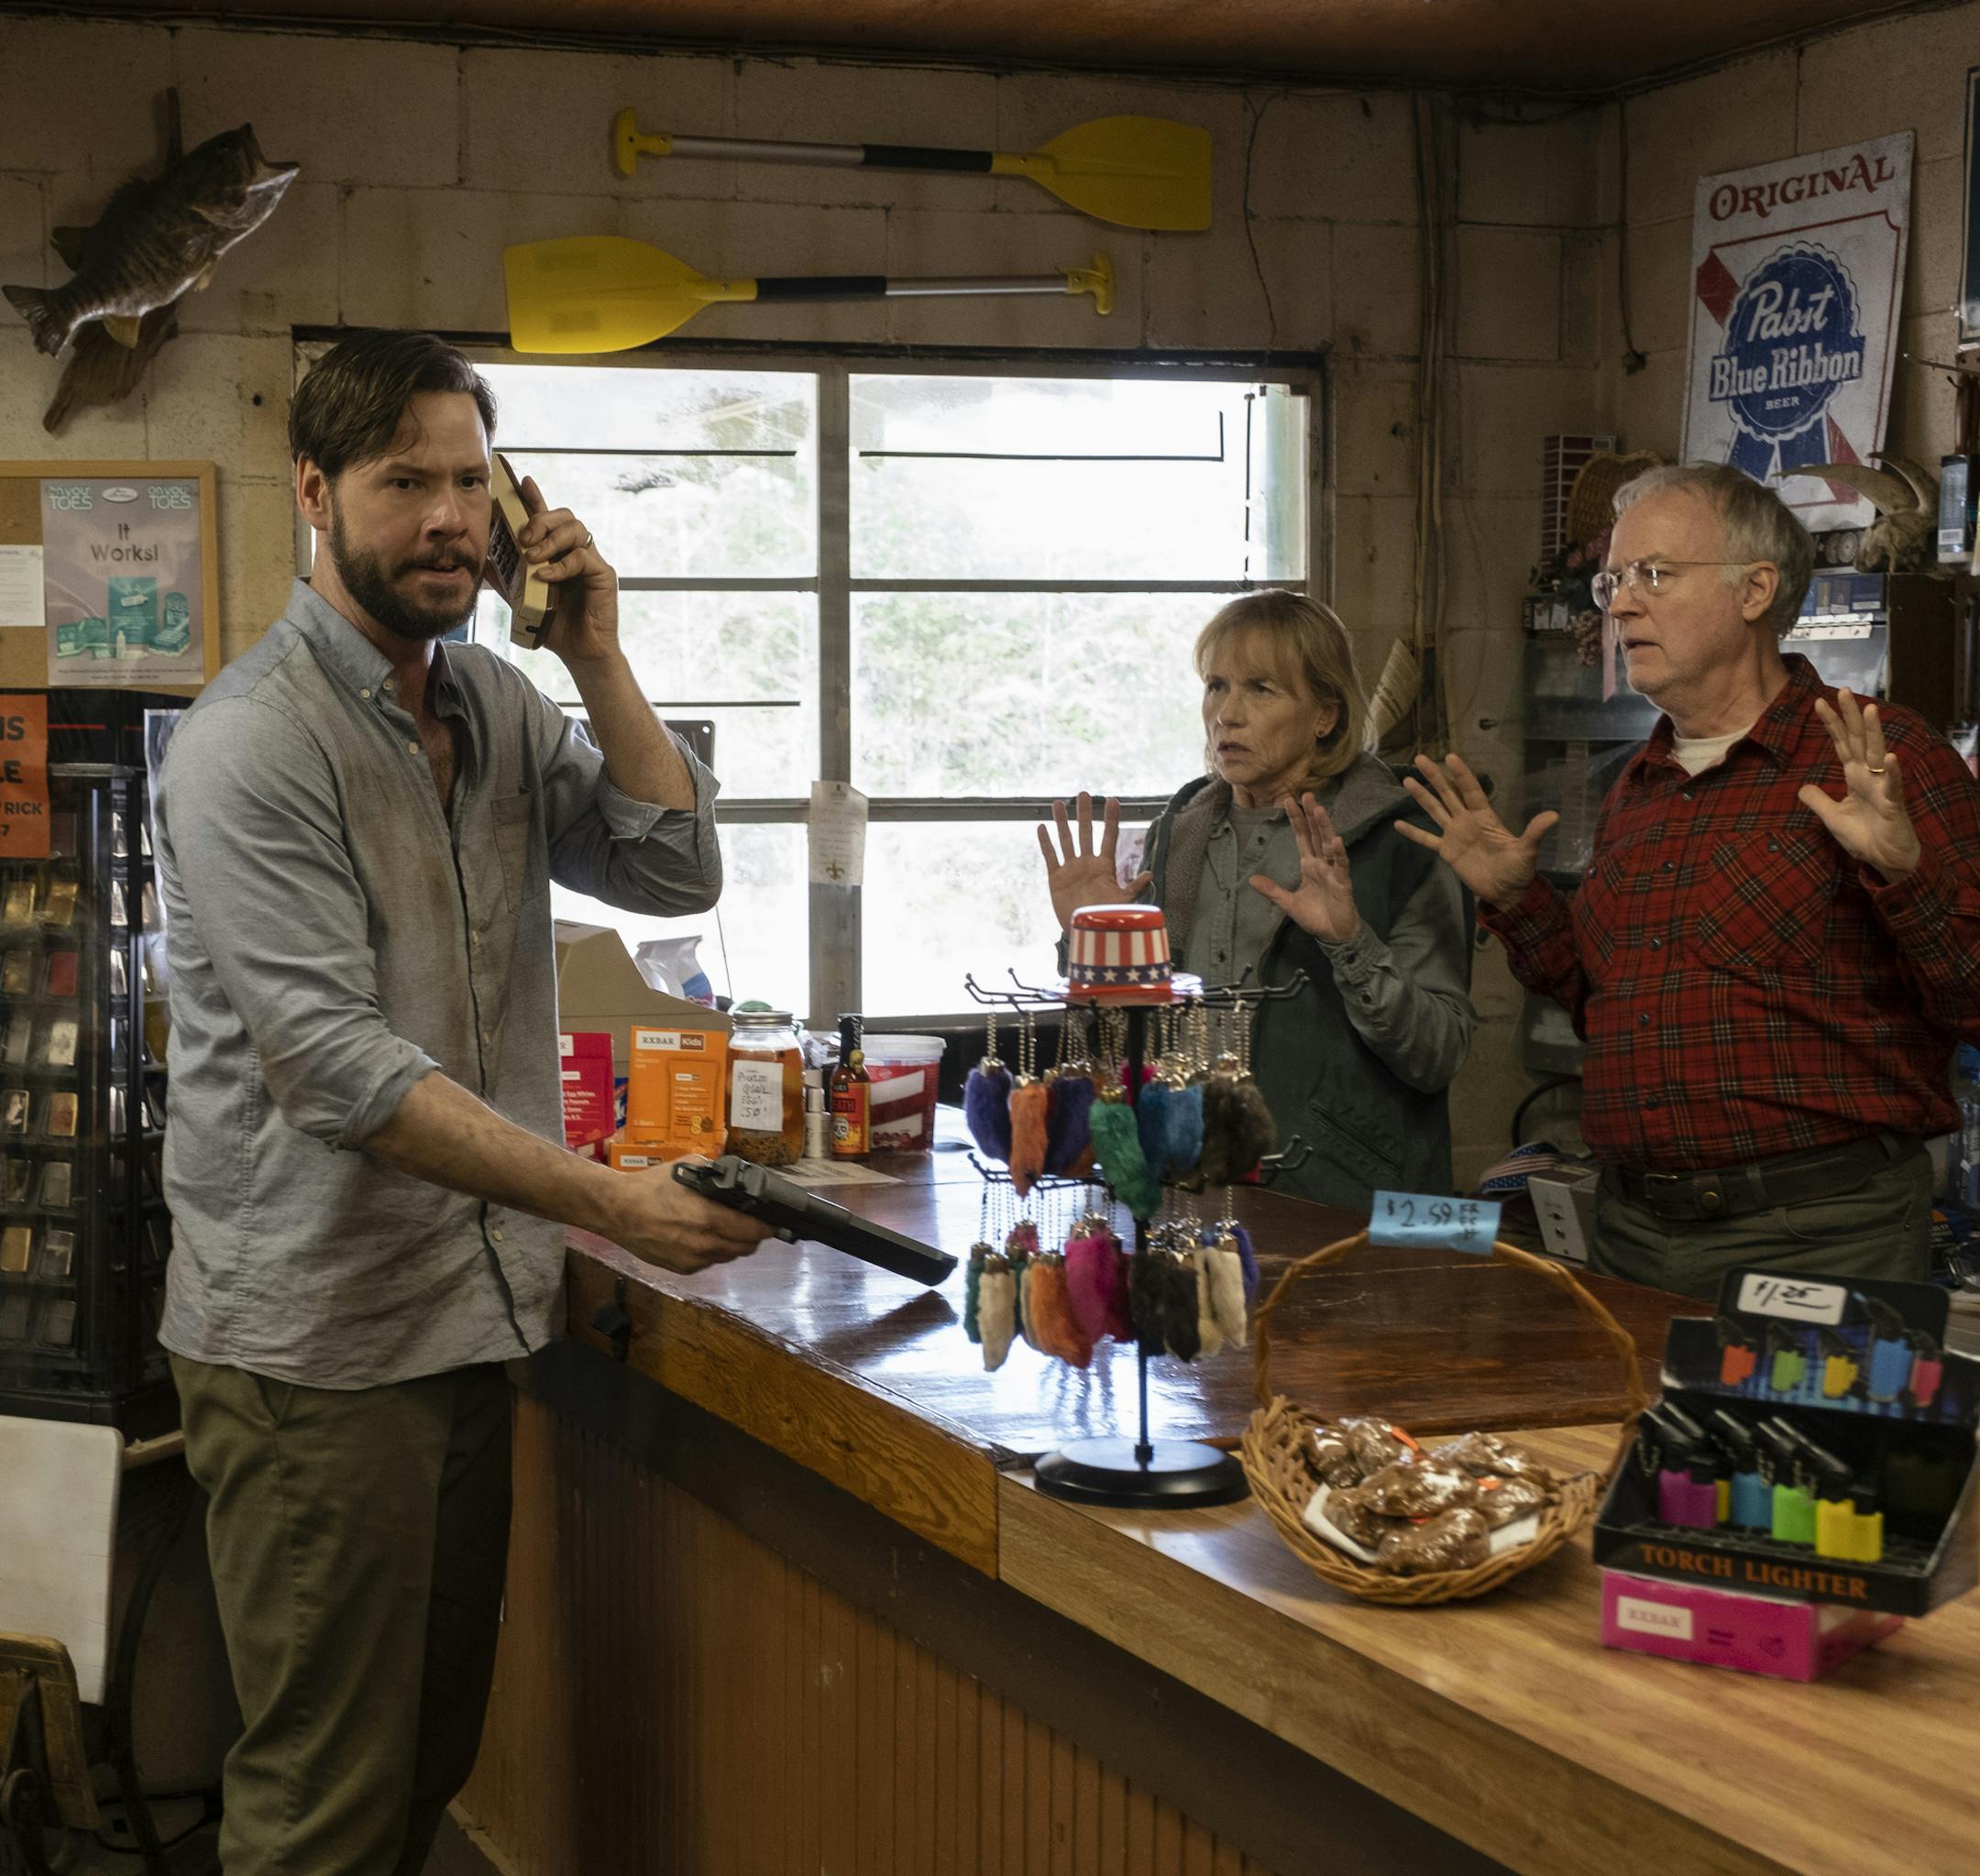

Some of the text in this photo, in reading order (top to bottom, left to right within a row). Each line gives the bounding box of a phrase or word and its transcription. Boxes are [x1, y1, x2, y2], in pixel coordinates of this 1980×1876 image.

[1709, 153, 1896, 222] ORIGINAL
[1746, 281, 1834, 343] Pabst
[1712, 344, 1860, 400] Blue Ribbon
[1765, 395, 1799, 411] BEER
[50, 495, 93, 510] TOES
[148, 495, 192, 510] TOES
[91, 544, 159, 562] Works!
[5, 801, 43, 816] RICK
[681, 1037, 703, 1048] Kids
[1641, 1543, 1869, 1599] TORCH LIGHTER
